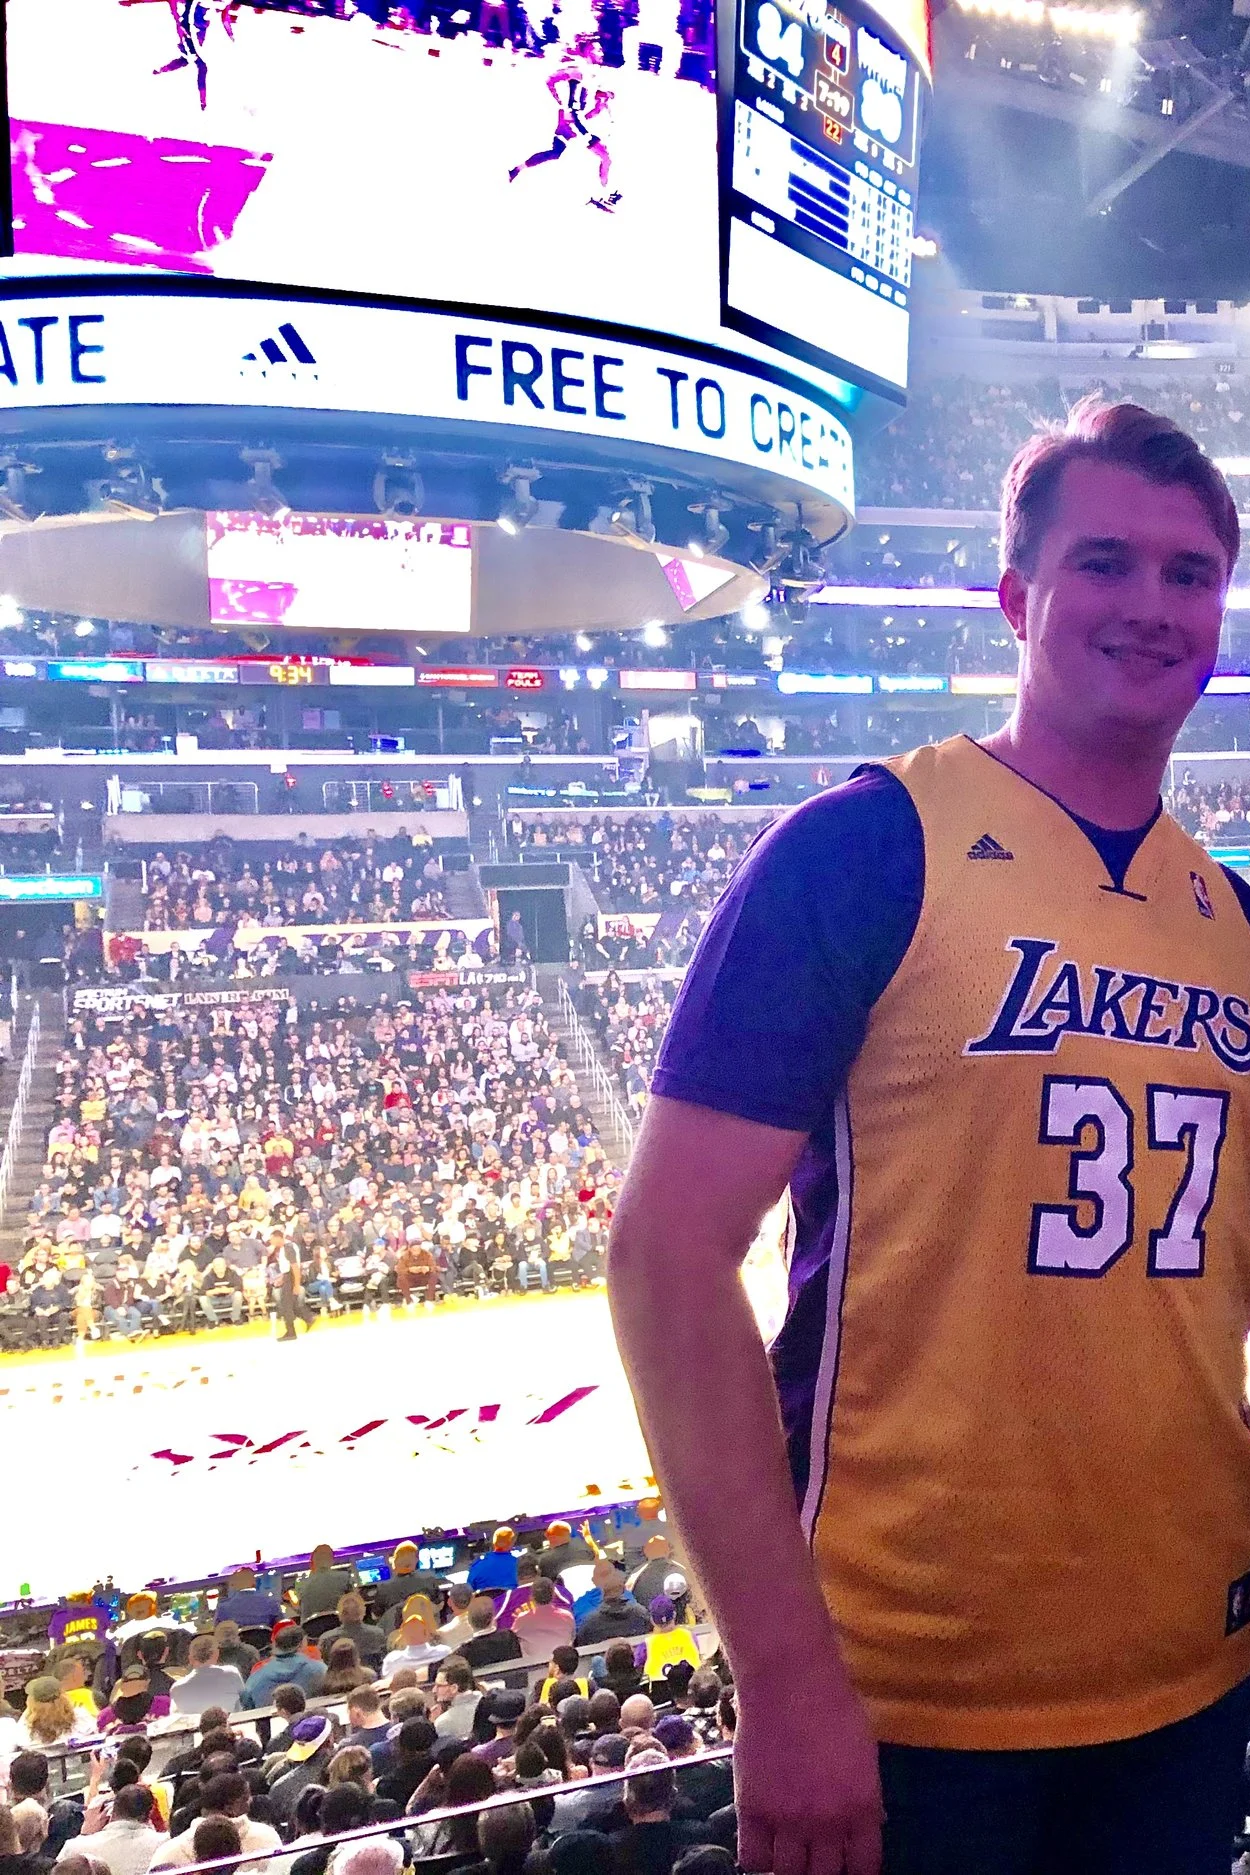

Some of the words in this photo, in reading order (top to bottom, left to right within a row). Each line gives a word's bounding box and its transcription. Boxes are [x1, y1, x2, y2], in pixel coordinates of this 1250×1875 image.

[831, 43, 842, 66] 4
[825, 118, 841, 142] 22
[455, 334, 627, 421] FREE
[656, 367, 726, 439] TO
[750, 392, 849, 492] CRE
[269, 664, 312, 685] 9:34
[511, 671, 539, 680] TEAM
[1027, 1074, 1232, 1279] 37
[63, 1617, 98, 1637] JAMES
